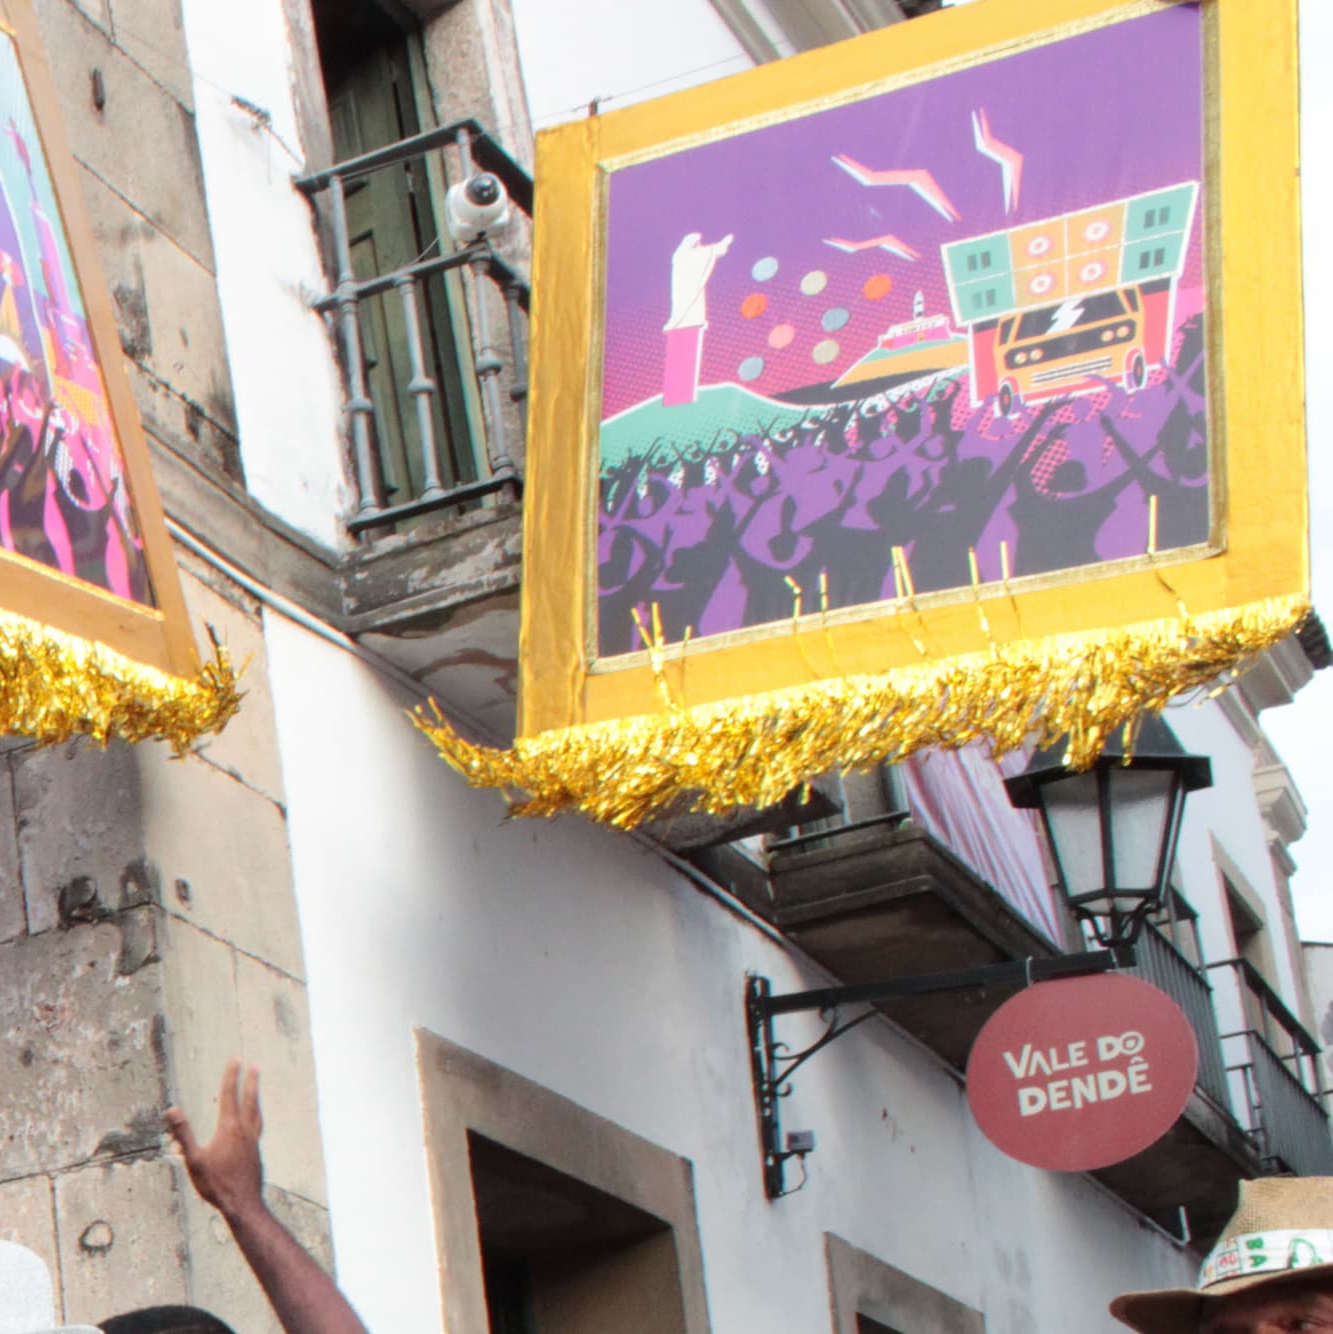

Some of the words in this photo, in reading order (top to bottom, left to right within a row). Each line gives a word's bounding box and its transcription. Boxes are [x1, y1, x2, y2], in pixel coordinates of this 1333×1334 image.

[1003, 1042, 1089, 1081] VALE
[1097, 1030, 1146, 1062] DO
[1016, 1056, 1154, 1118] DENDÊ
